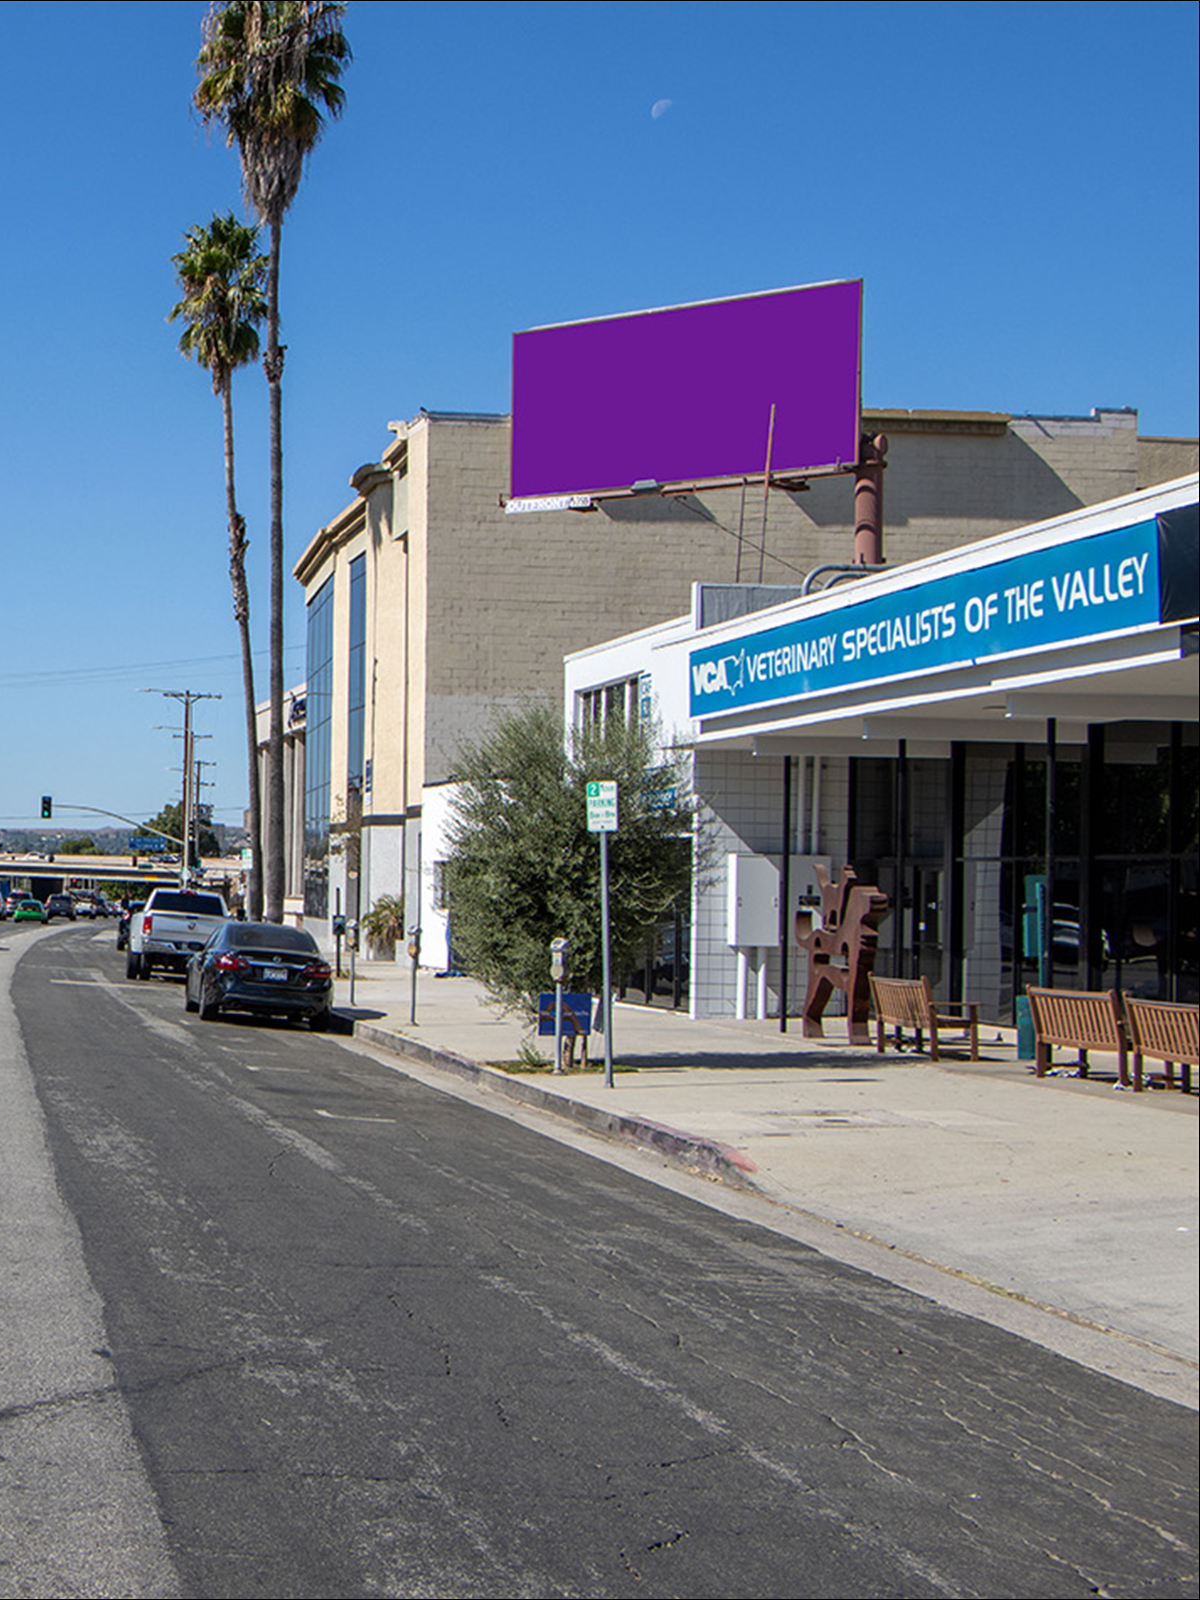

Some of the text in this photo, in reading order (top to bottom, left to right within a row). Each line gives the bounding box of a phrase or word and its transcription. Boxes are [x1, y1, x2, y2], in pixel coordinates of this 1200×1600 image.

[692, 553, 1149, 695] VCA VETERINARY SPECIALISTS OF THE VALLEY
